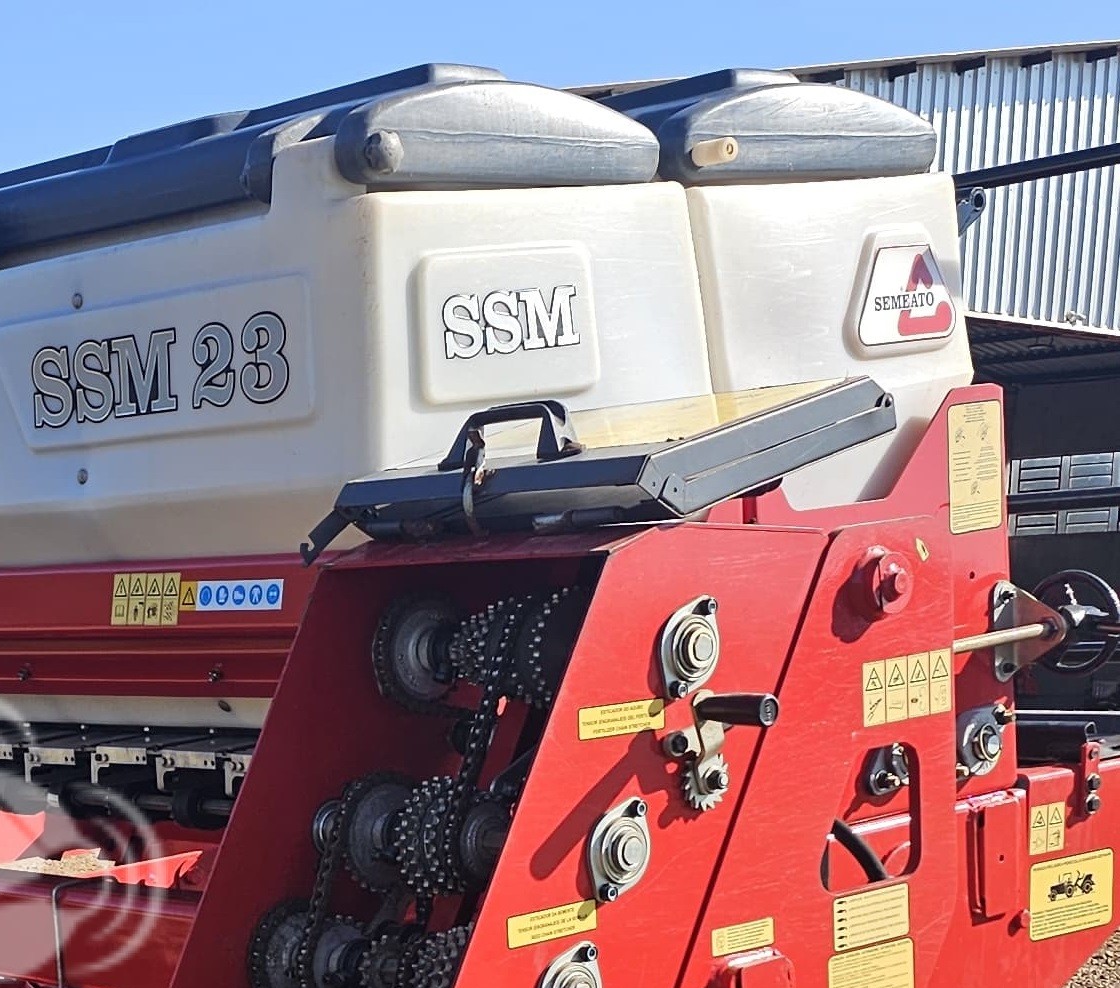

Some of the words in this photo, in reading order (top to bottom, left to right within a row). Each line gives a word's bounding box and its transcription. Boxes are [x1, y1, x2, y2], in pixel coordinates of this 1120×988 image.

[442, 284, 581, 359] SSM
[874, 291, 935, 312] SEMEATO
[31, 327, 179, 429] SSM
[192, 310, 290, 409] 23
